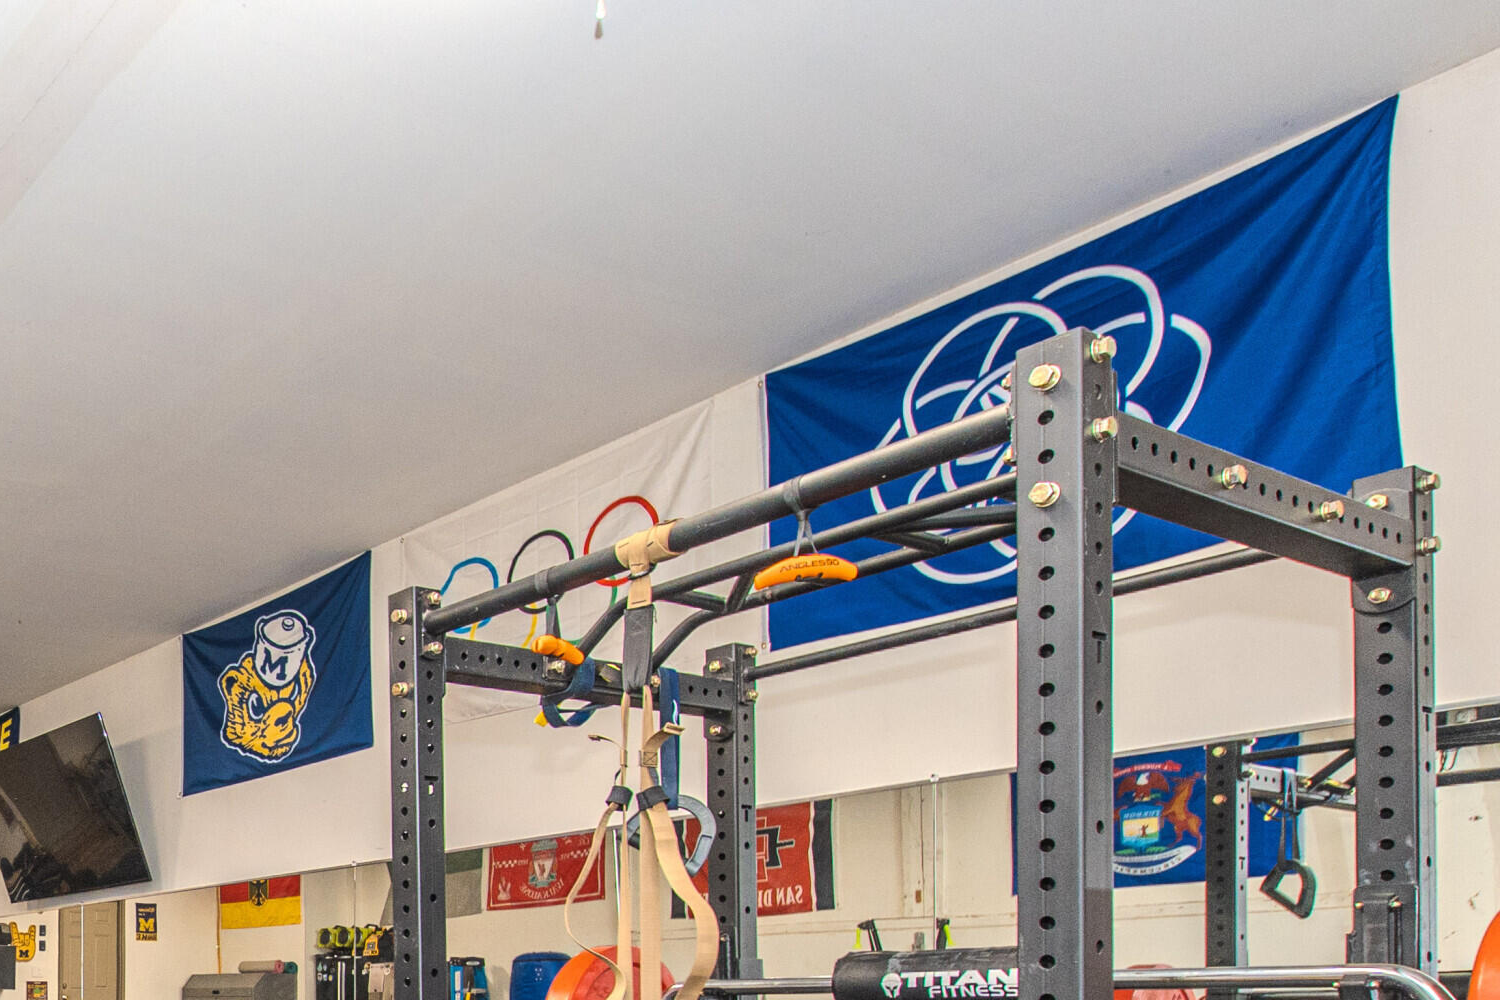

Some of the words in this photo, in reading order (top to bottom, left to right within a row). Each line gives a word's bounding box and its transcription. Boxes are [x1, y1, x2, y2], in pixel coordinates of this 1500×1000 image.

[780, 558, 840, 573] ANGLES90
[261, 647, 289, 681] M
[900, 967, 1019, 988] TITAN
[928, 985, 1019, 999] FITNESS
